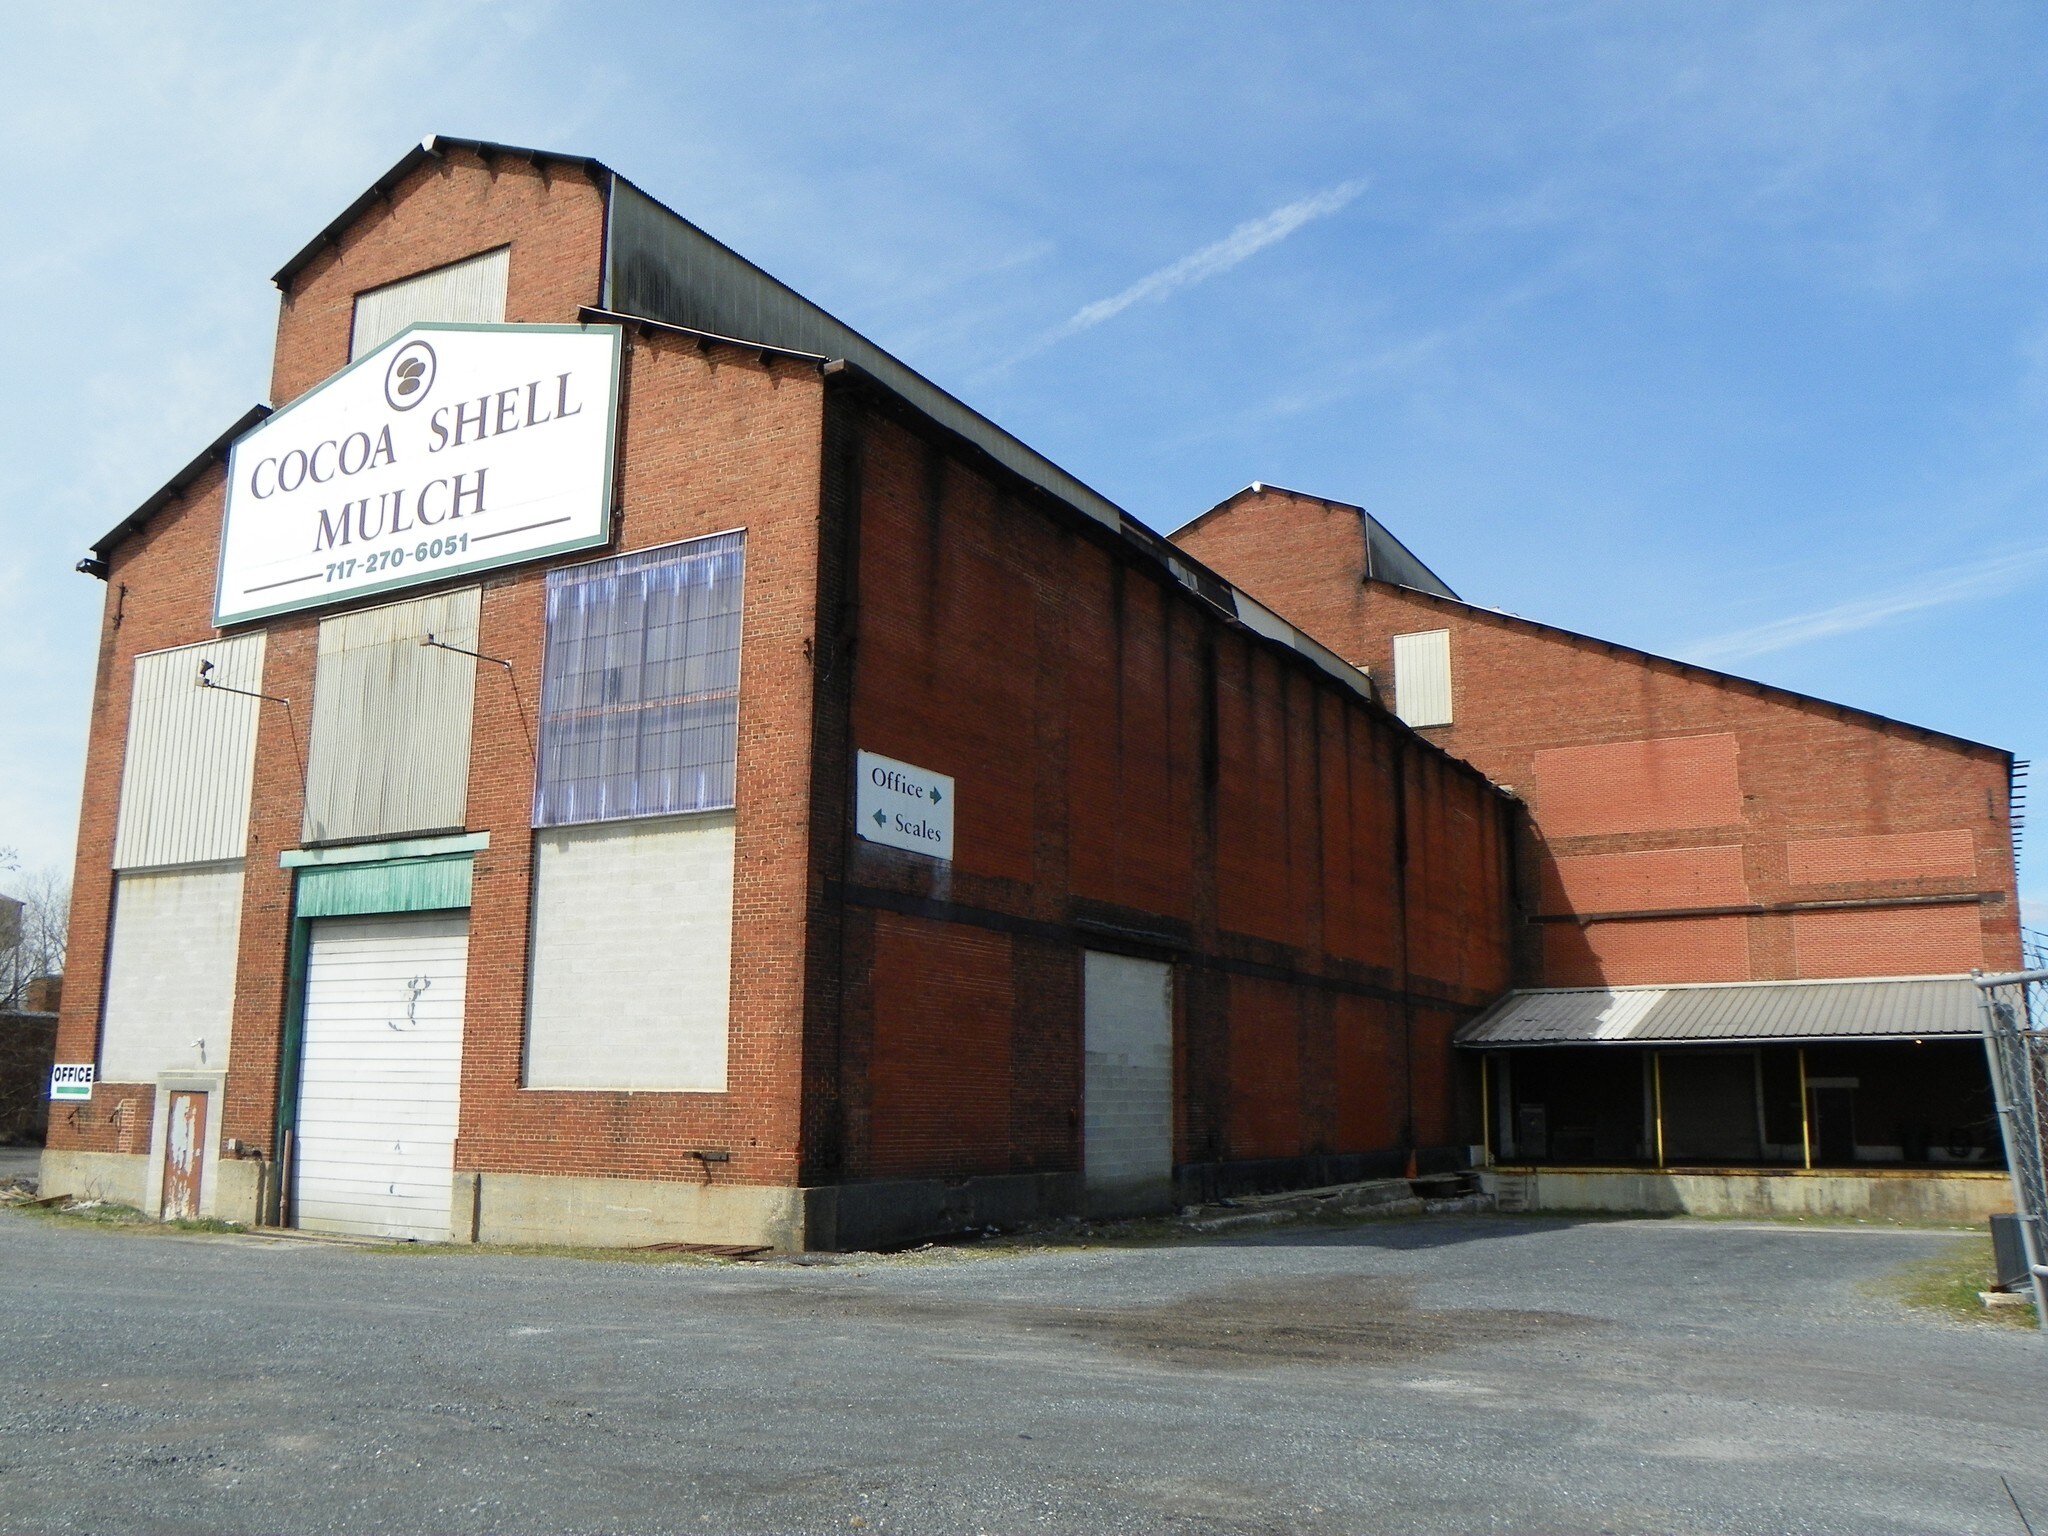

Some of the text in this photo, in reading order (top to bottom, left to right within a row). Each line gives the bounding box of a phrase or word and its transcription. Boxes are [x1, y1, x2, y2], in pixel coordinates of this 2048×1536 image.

[250, 372, 582, 500] COCOA SHELL
[313, 467, 490, 553] MULCH
[326, 533, 468, 582] 717-270-6051
[872, 767, 923, 798] Office
[895, 813, 941, 842] Scales
[54, 1066, 92, 1082] OFFICE
